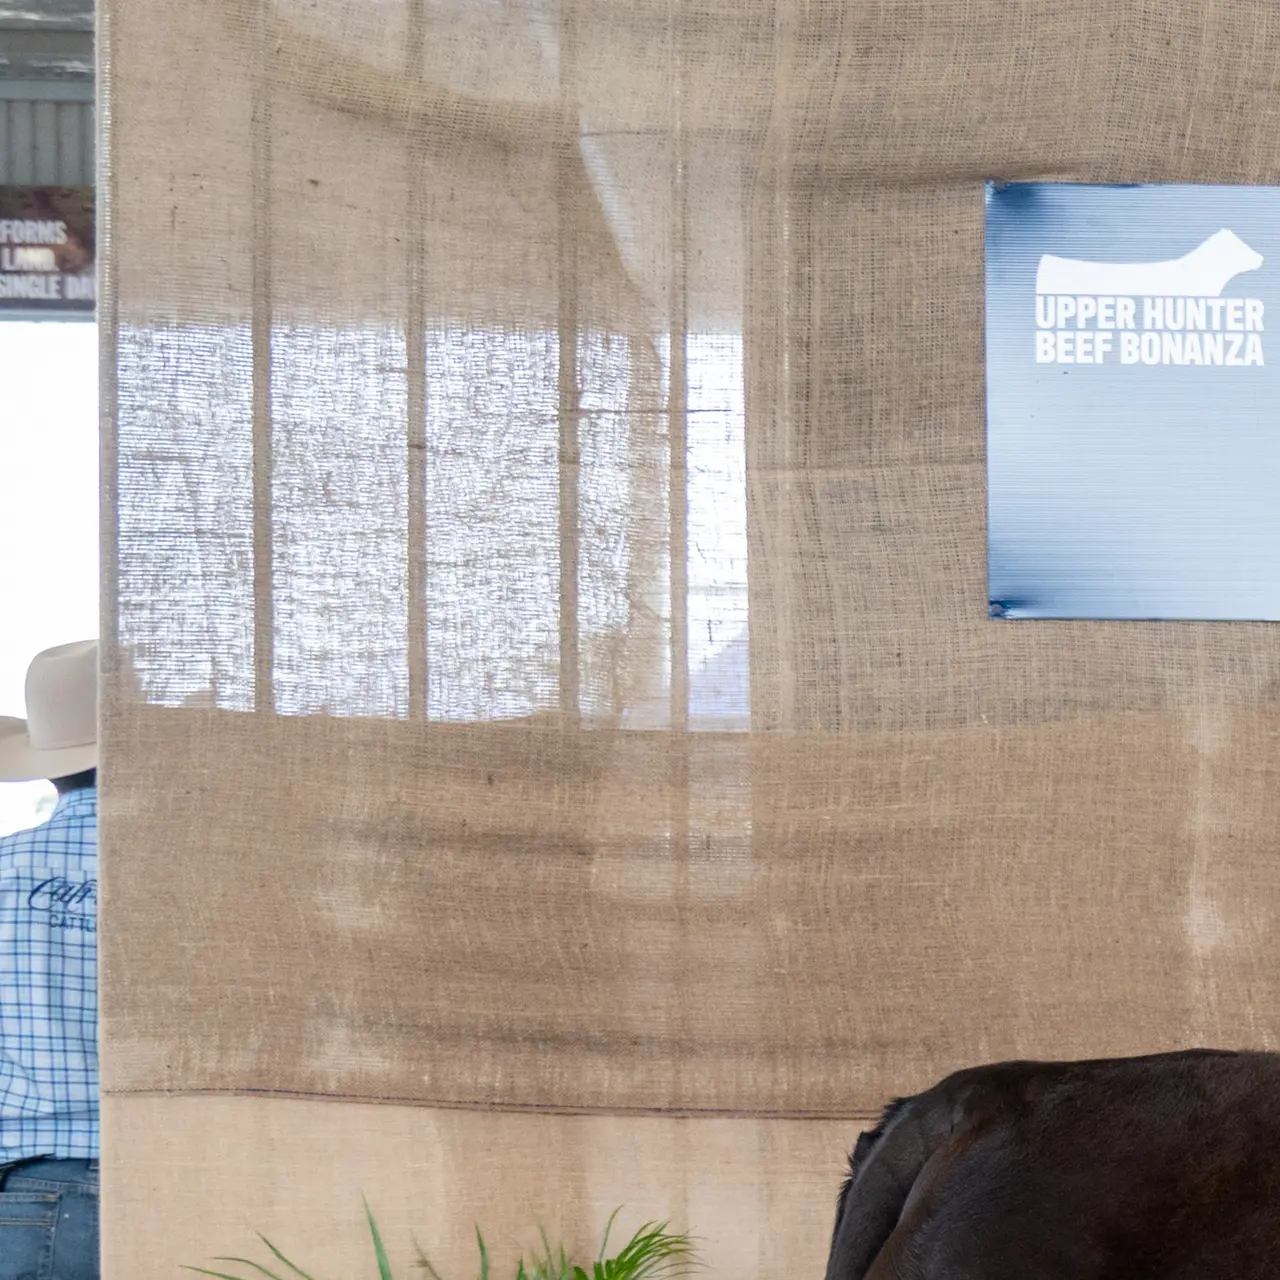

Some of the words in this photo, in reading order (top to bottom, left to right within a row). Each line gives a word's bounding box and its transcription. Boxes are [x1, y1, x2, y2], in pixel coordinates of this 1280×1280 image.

[1035, 296, 1136, 329] UPPER
[1143, 297, 1265, 331] HUNTER
[1035, 331, 1113, 364] BEEF
[1120, 331, 1265, 366] BONANZA
